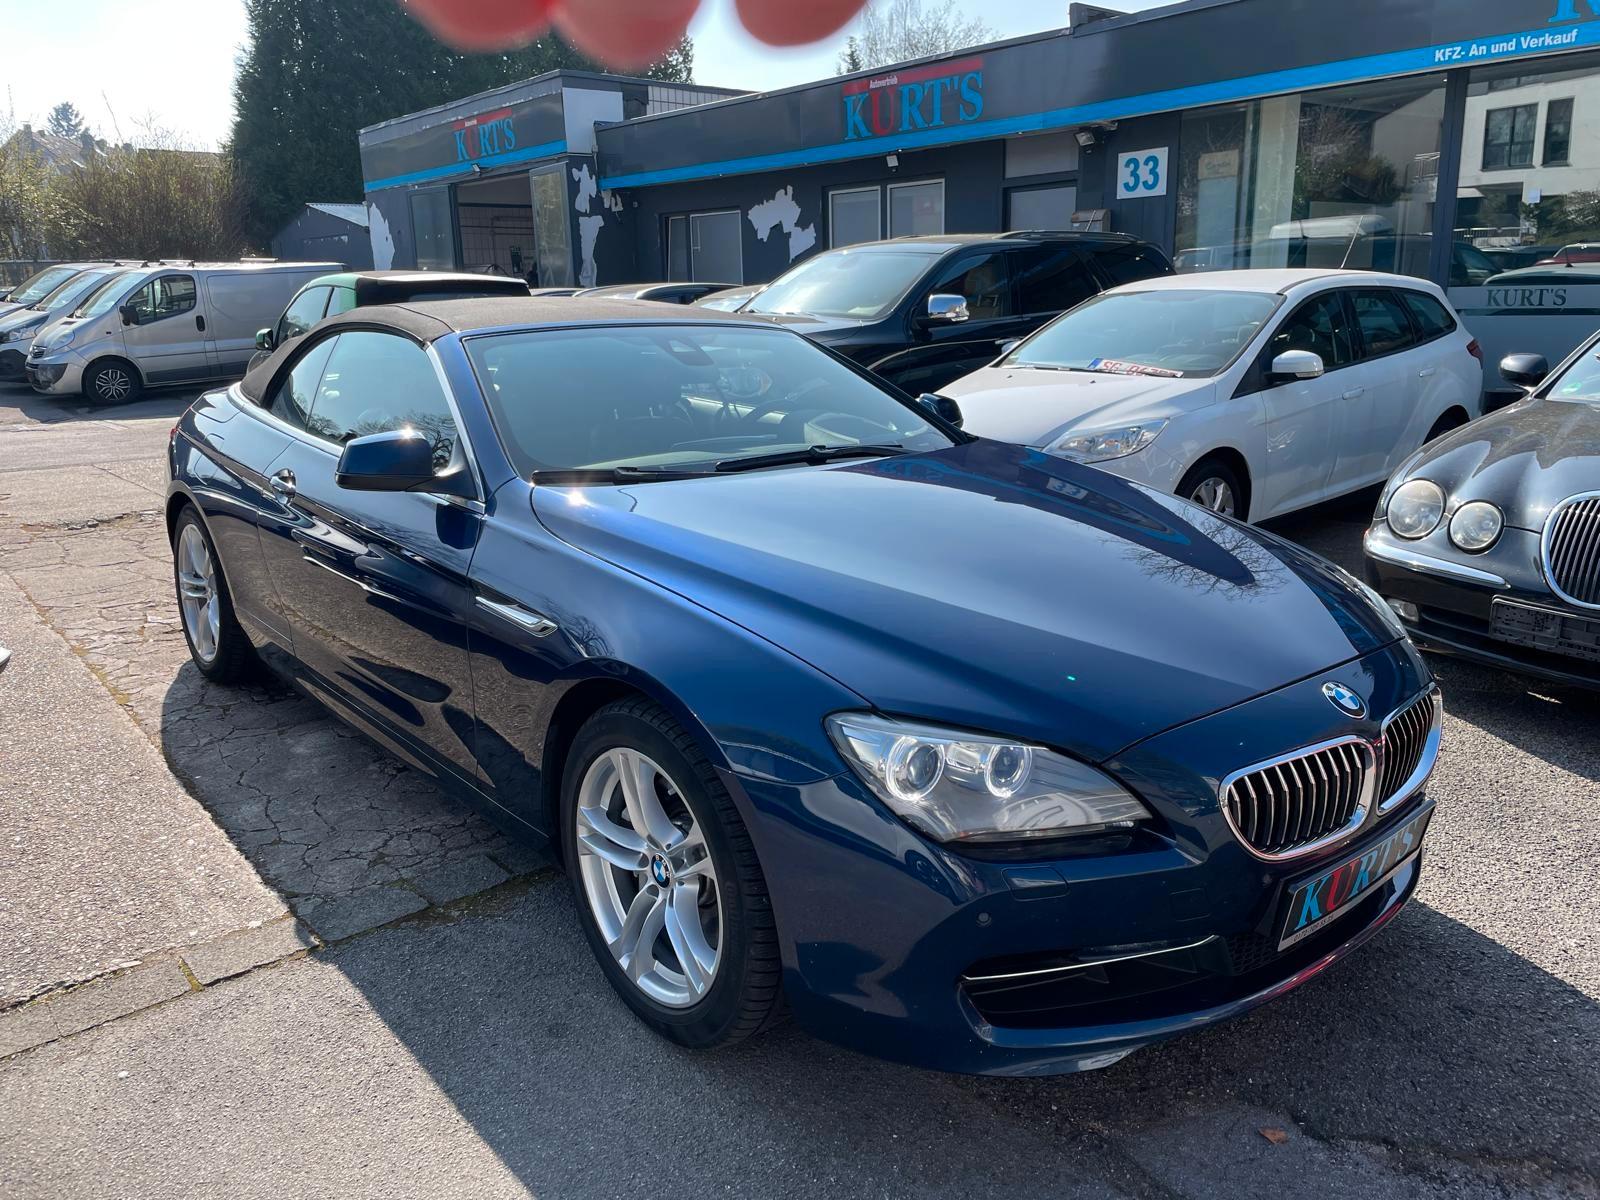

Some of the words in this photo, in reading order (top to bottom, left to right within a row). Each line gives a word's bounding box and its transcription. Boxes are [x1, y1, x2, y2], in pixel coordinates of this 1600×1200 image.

[1434, 46, 1466, 62] KFZ-
[1469, 43, 1487, 57] An
[1491, 38, 1516, 54] und
[1520, 28, 1578, 50] Verkauf
[1123, 155, 1160, 192] 33
[1487, 288, 1567, 307] KURT'S
